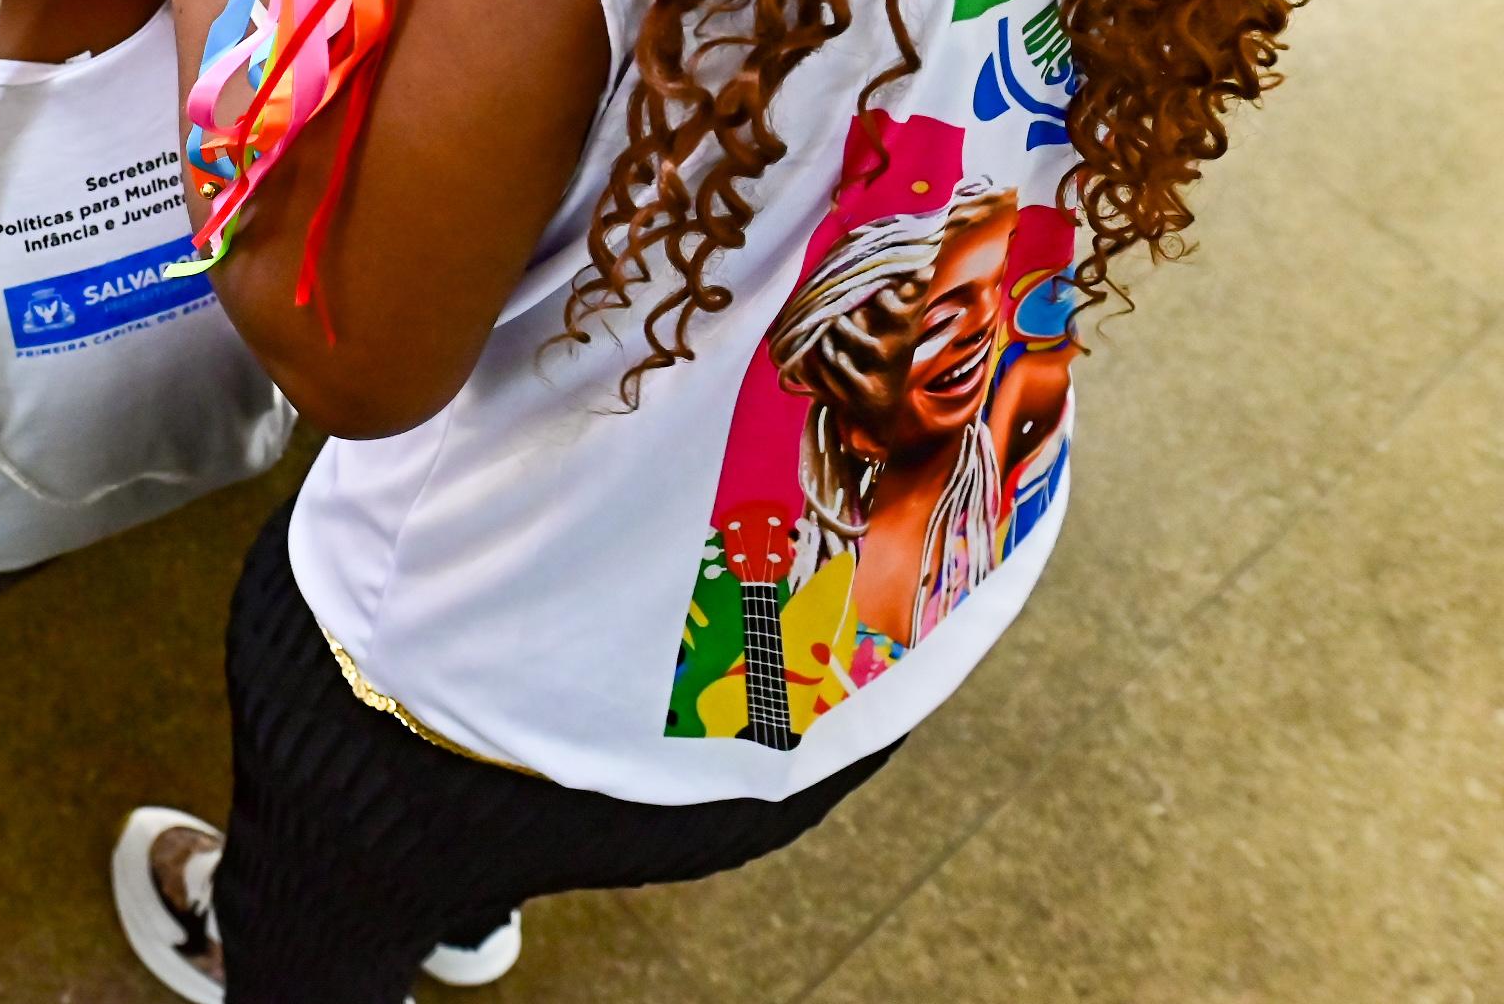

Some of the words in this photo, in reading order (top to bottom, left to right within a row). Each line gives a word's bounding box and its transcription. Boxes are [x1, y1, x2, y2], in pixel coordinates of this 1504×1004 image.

[86, 150, 178, 192] Secretaria
[80, 196, 120, 221] para
[24, 224, 99, 253] Infância
[105, 219, 115, 231] e
